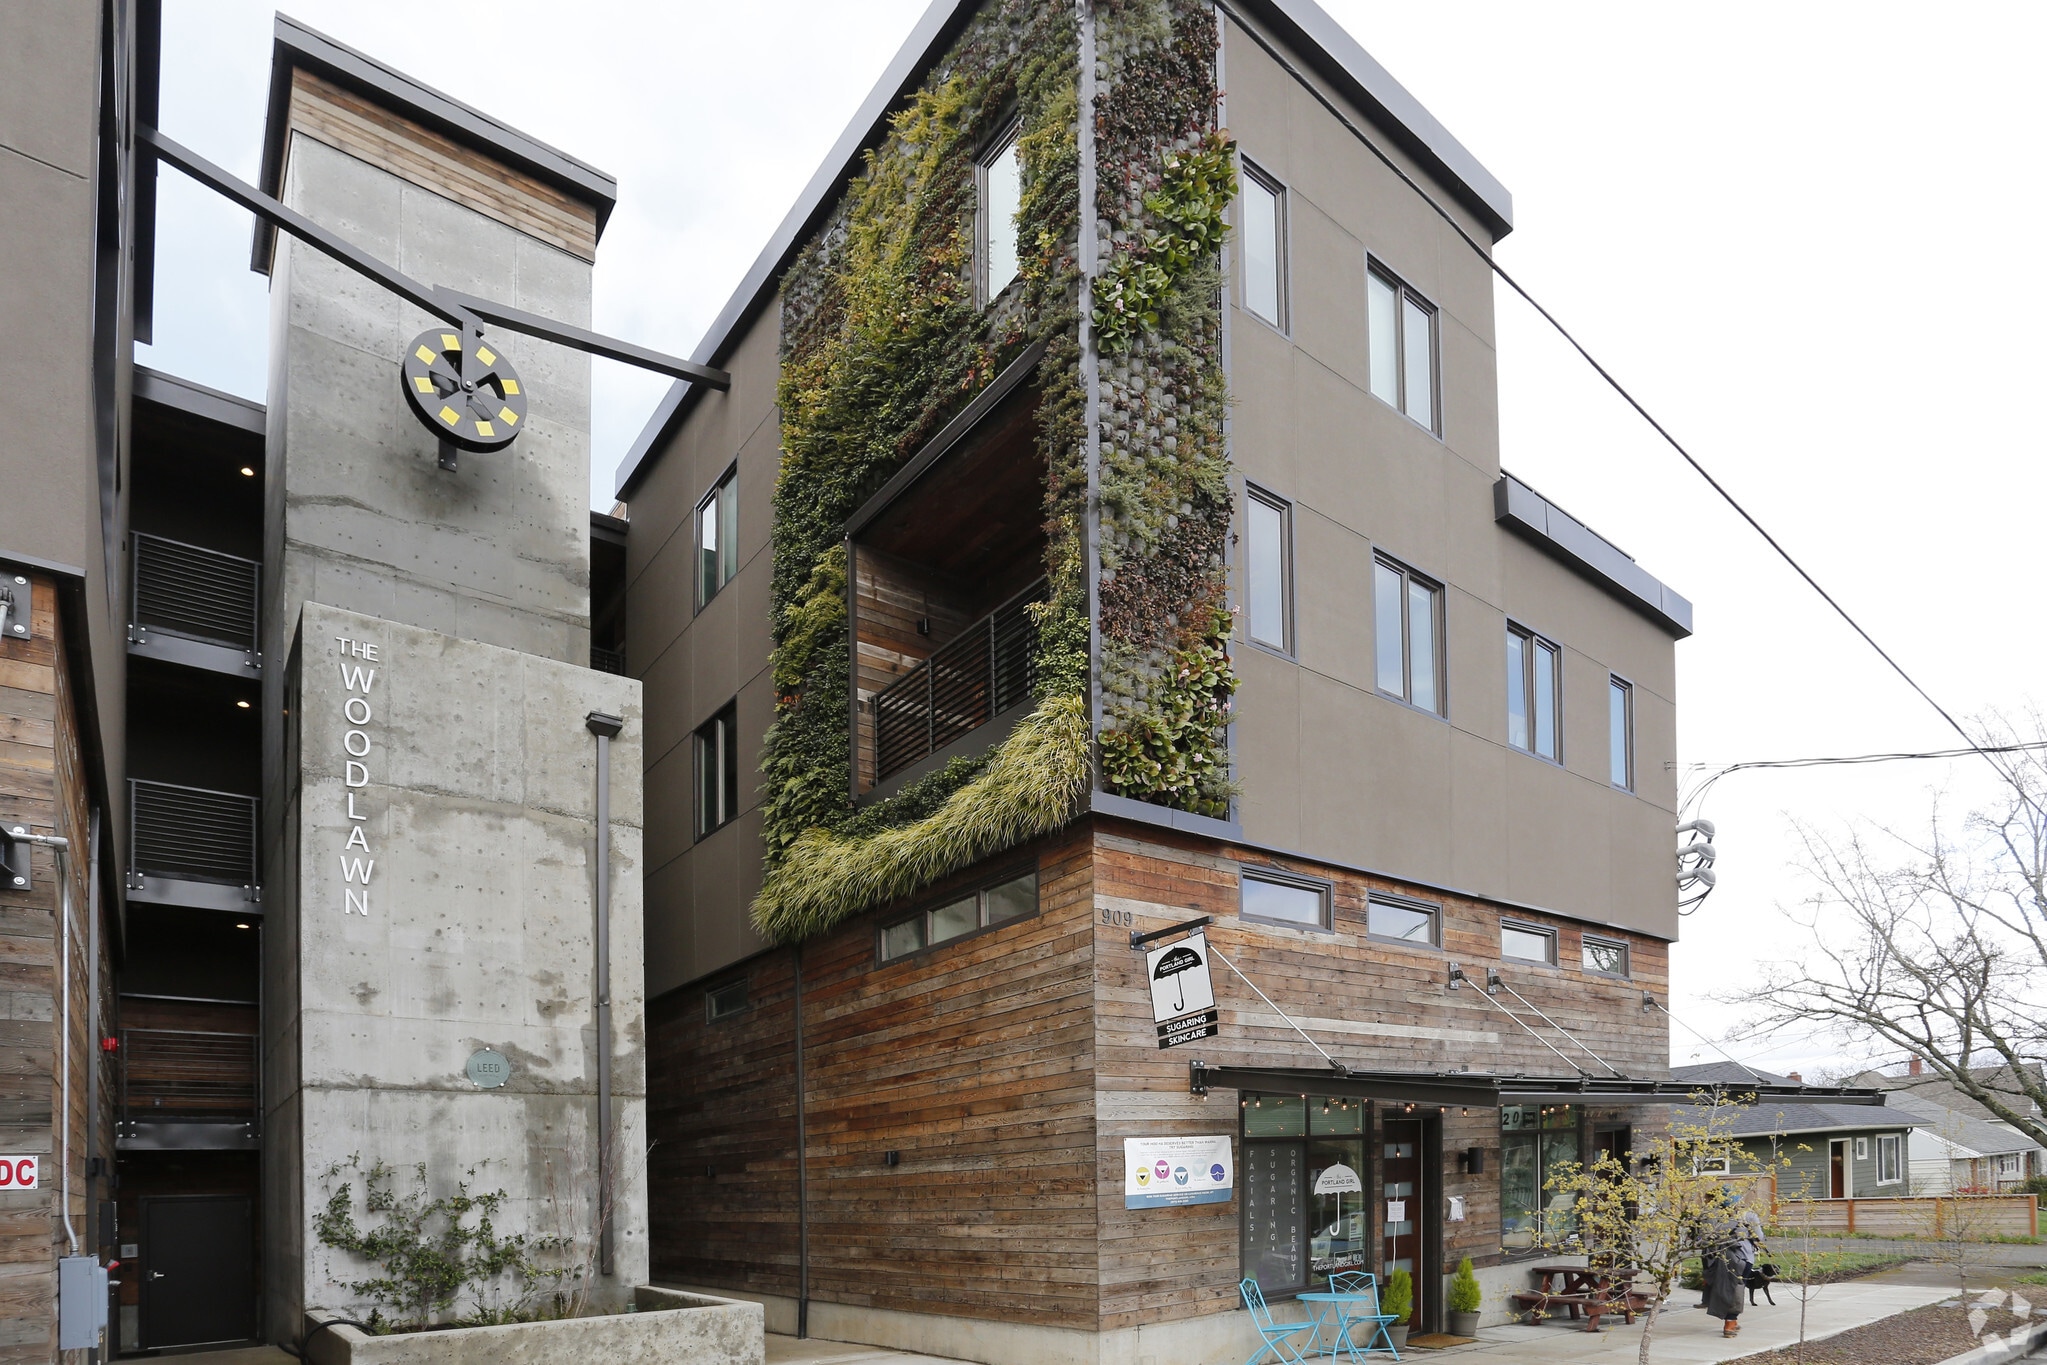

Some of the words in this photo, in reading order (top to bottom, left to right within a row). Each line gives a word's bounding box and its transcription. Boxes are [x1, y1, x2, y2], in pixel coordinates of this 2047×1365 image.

[335, 636, 379, 662] THE
[340, 662, 375, 916] WOODLAWN
[1101, 908, 1133, 927] 909
[1159, 959, 1184, 972] PORTLAND
[1166, 1015, 1207, 1033] SUGARING
[1168, 1028, 1207, 1046] SKINCARE
[477, 1063, 500, 1073] LEED
